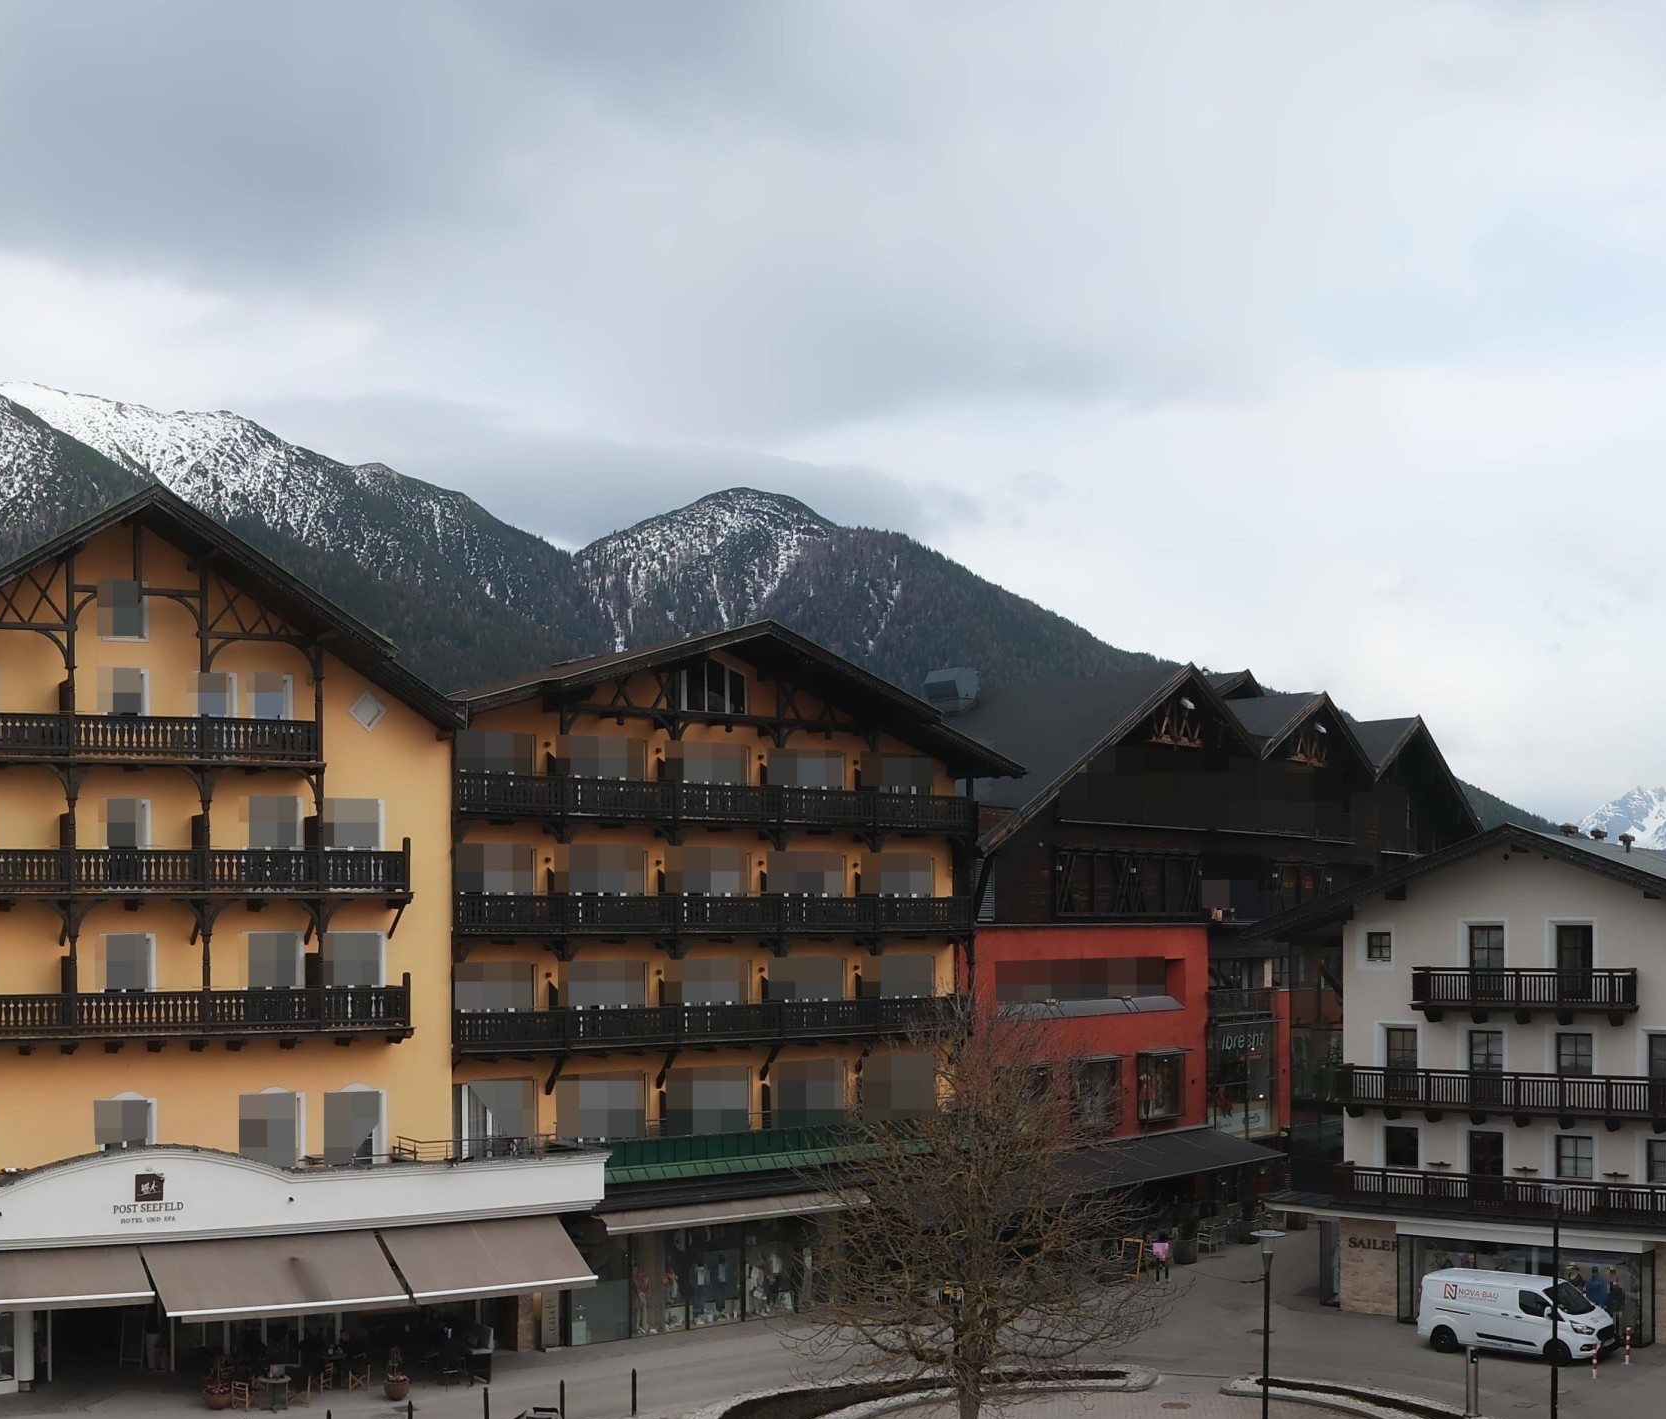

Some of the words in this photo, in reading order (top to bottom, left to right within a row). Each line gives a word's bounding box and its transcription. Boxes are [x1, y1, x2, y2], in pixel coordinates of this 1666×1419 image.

[113, 1204, 138, 1214] POST
[140, 1202, 184, 1212] SEEFELD
[1458, 1288, 1480, 1297] NOVA
[1482, 1290, 1499, 1300] BAU
